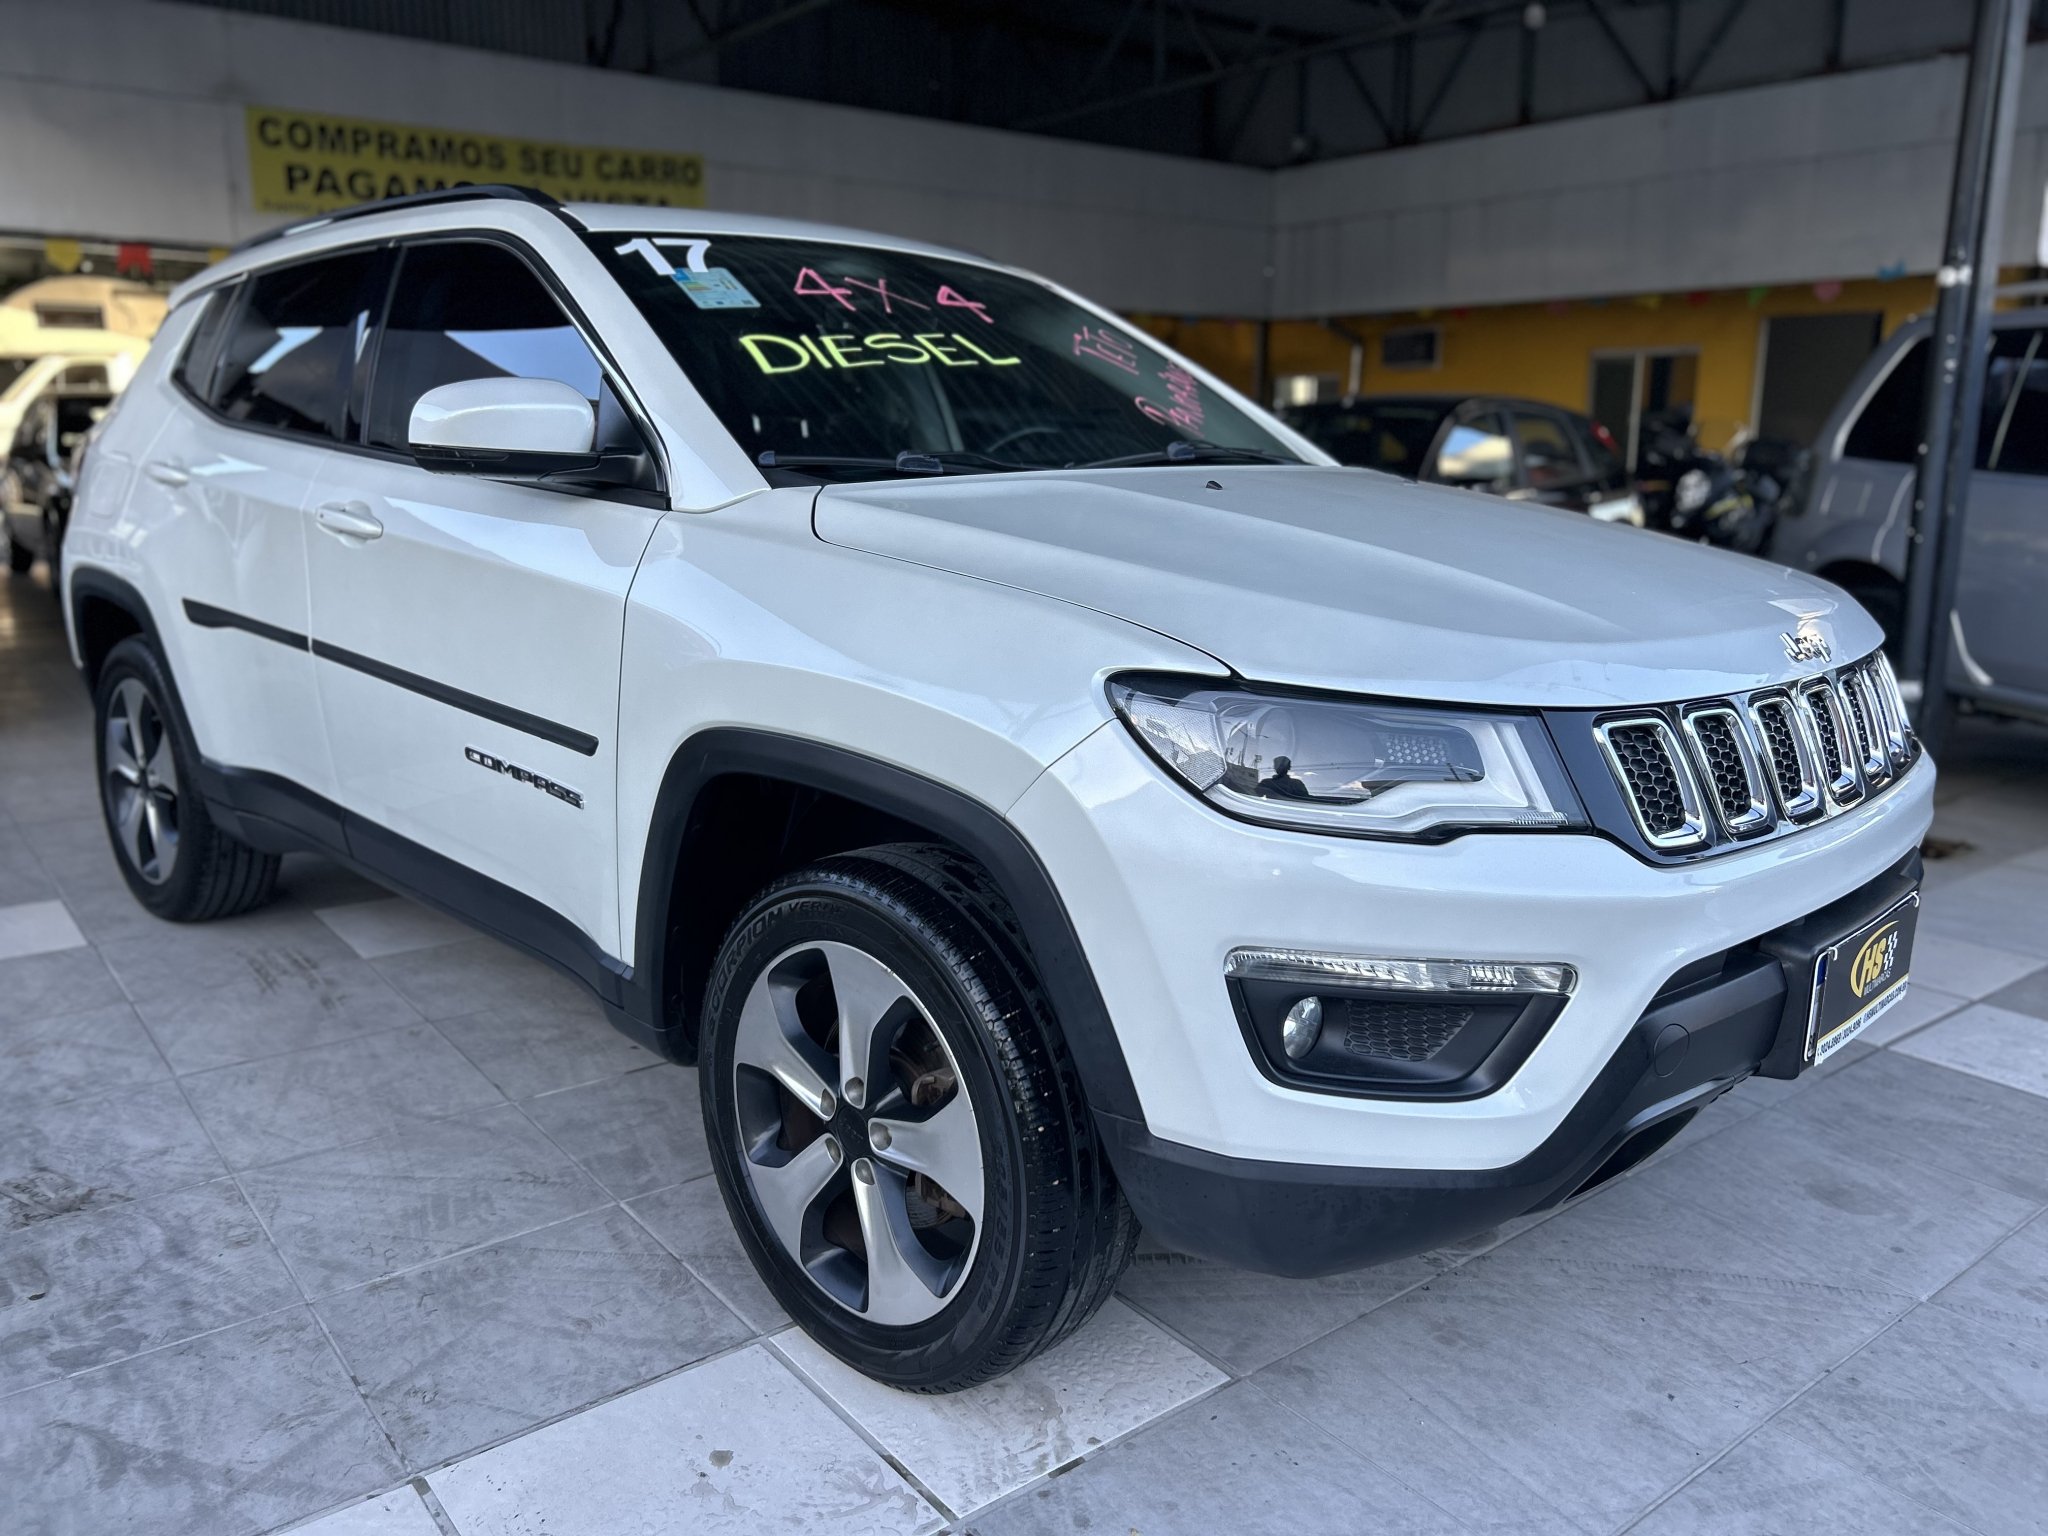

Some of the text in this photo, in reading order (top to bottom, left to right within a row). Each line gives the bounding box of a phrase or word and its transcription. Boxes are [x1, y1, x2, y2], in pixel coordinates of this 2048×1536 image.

[258, 117, 701, 187] COMPRAMOS SEU CARRO
[614, 237, 711, 276] 17
[738, 333, 1022, 376] DIESEL
[464, 745, 585, 811] COMPASS
[708, 909, 784, 1028] SCORPION
